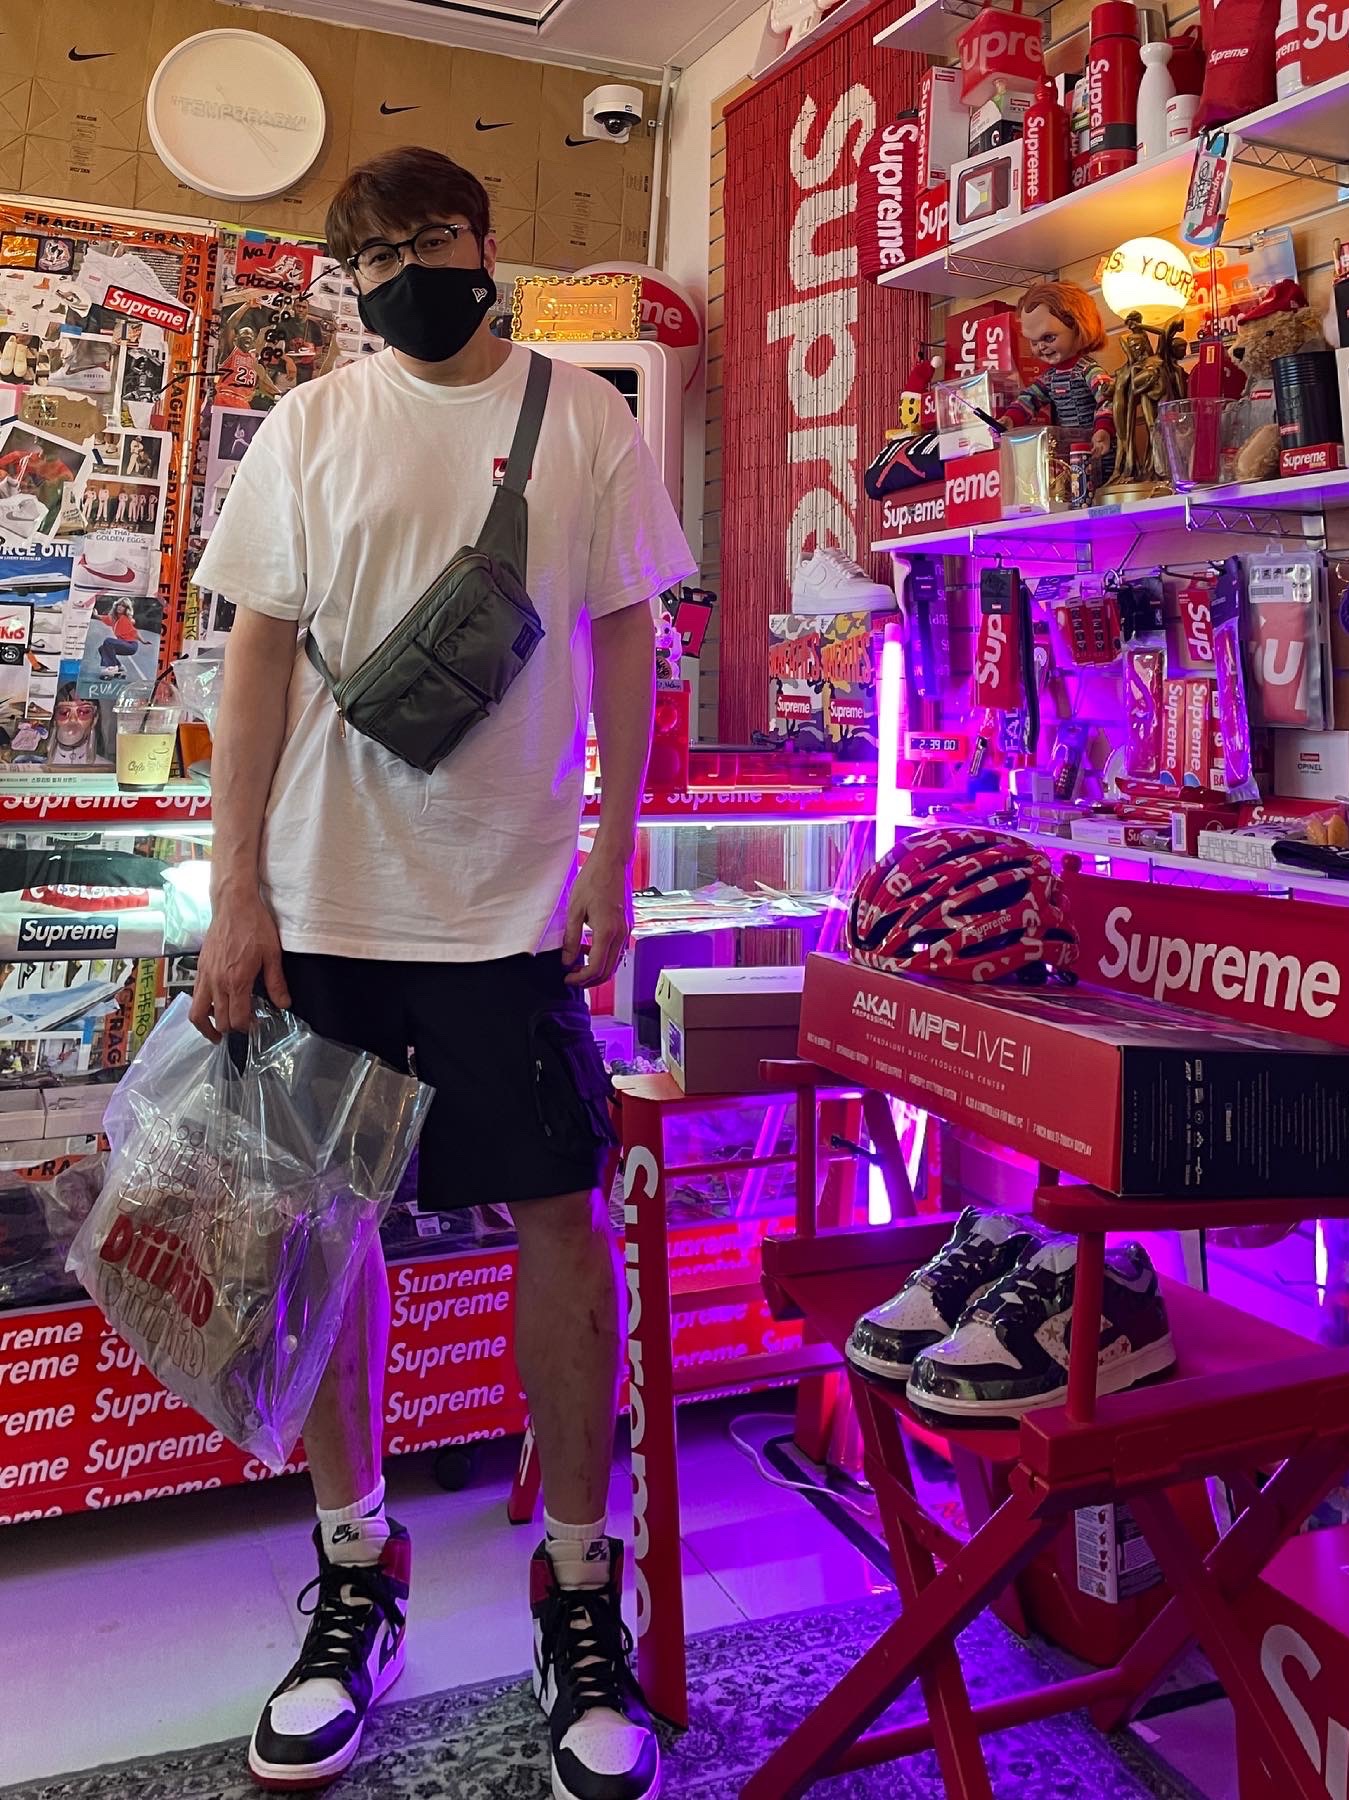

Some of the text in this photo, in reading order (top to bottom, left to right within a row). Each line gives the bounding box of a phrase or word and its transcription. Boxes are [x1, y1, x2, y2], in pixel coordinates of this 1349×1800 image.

[1209, 47, 1249, 65] Supreme
[917, 78, 931, 185] Supreme
[1025, 116, 1045, 197] Supreme
[1206, 171, 1224, 216] Supreme
[23, 212, 113, 238] FRAGILE
[109, 291, 184, 328] Supreme
[1283, 451, 1326, 470] Supreme
[777, 696, 810, 718] Supreme
[830, 700, 864, 723] Supreme
[1165, 683, 1183, 770] Supreme
[1187, 682, 1208, 772] Supreme
[1297, 763, 1323, 772] OPINEL
[22, 920, 117, 942] Supreme
[1098, 906, 1341, 1018] Supreme
[851, 1008, 896, 1030] PROFESSIONAL
[852, 990, 898, 1021] AKAI
[391, 1290, 510, 1332] Supreme
[387, 1335, 507, 1379] Supreme
[385, 1383, 505, 1428] Supreme
[84, 1429, 225, 1479] Supreme
